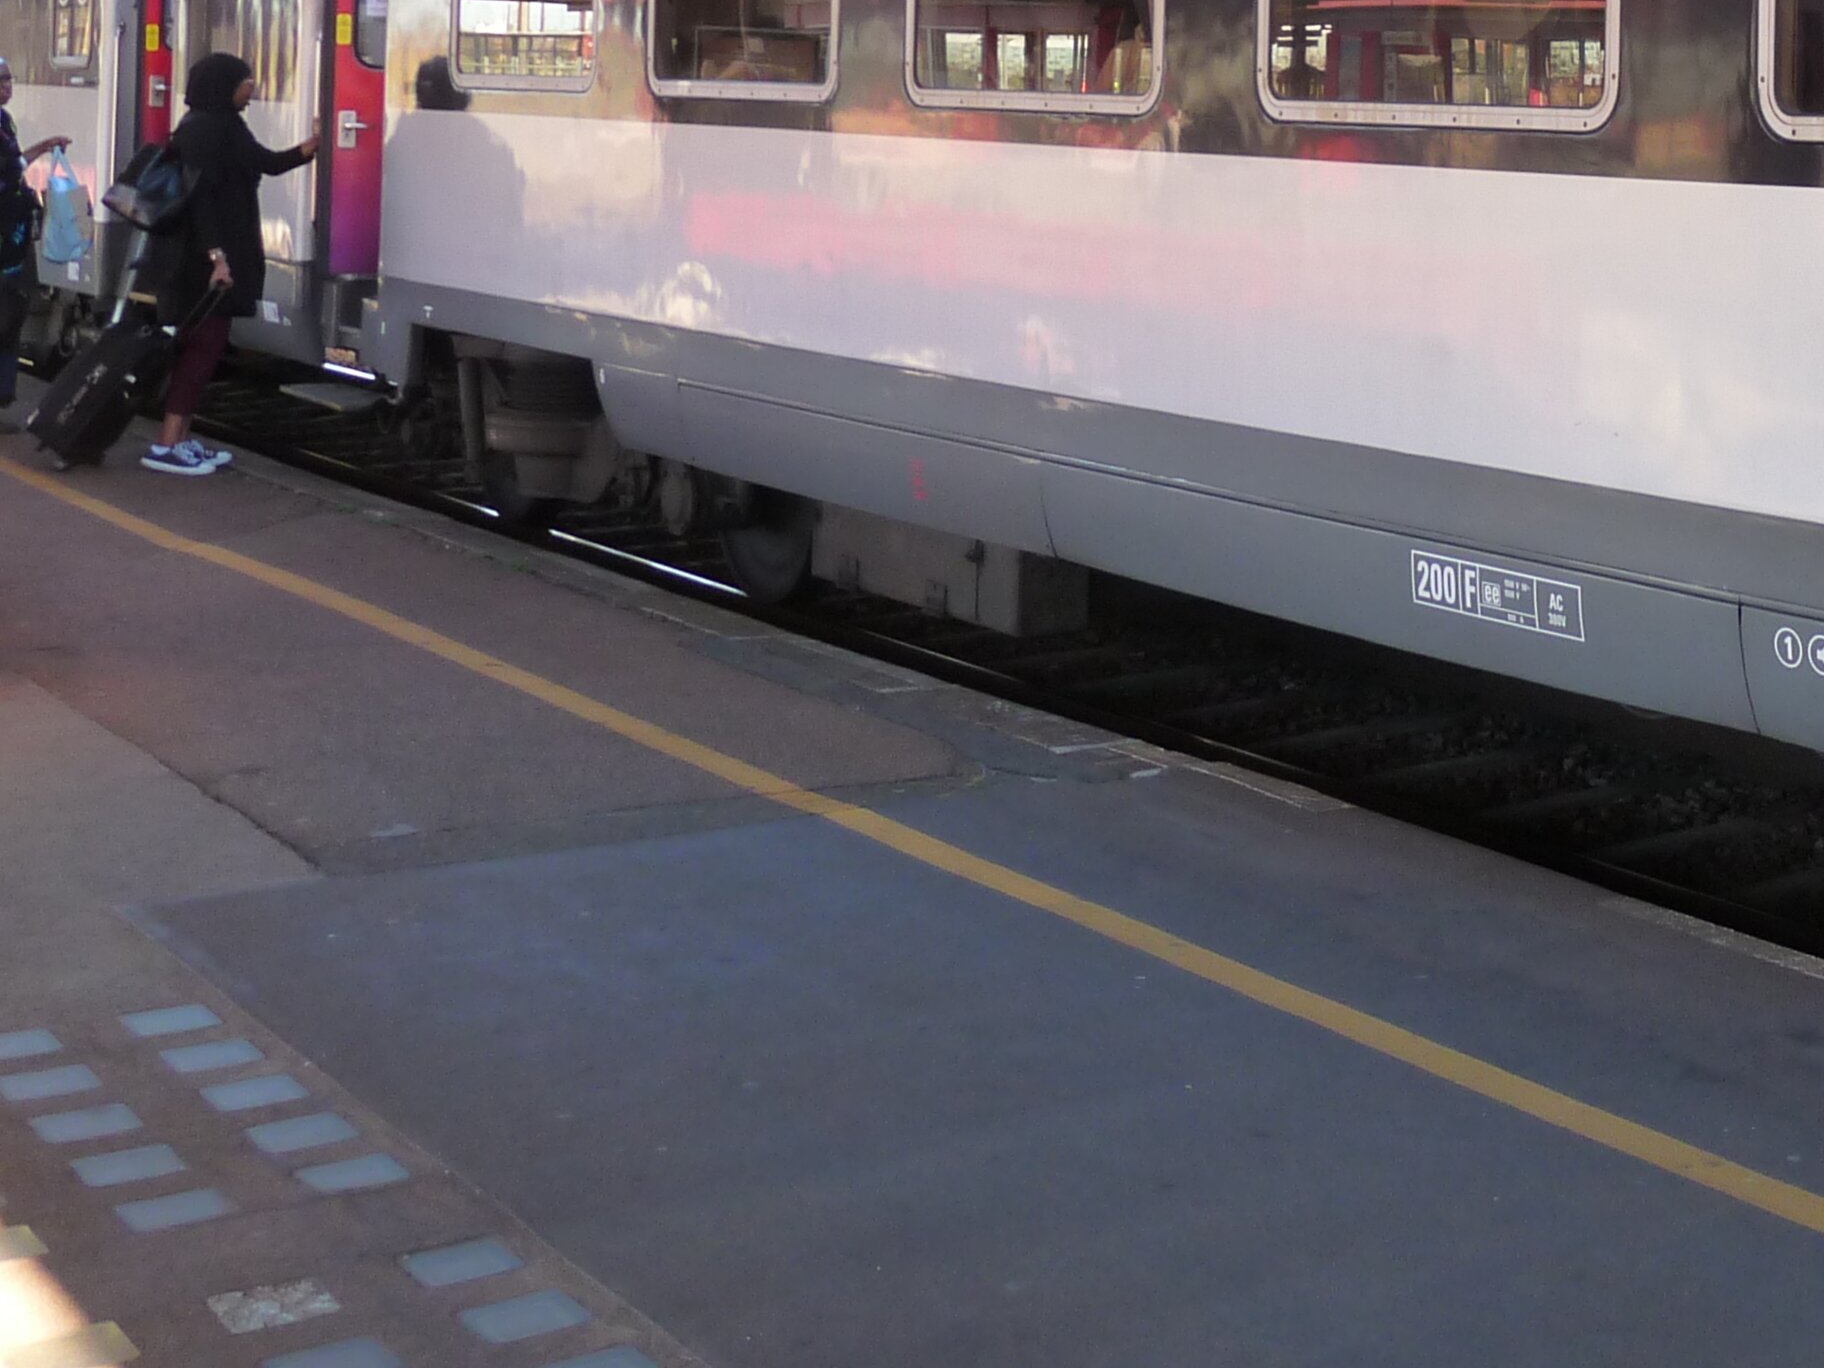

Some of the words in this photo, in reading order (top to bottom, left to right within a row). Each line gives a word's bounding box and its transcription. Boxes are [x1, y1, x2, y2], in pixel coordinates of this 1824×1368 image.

[1416, 560, 1457, 604] 200
[1464, 569, 1476, 608] F
[1484, 585, 1500, 605] ee
[1549, 592, 1564, 612] AC
[1784, 635, 1793, 661] 1
